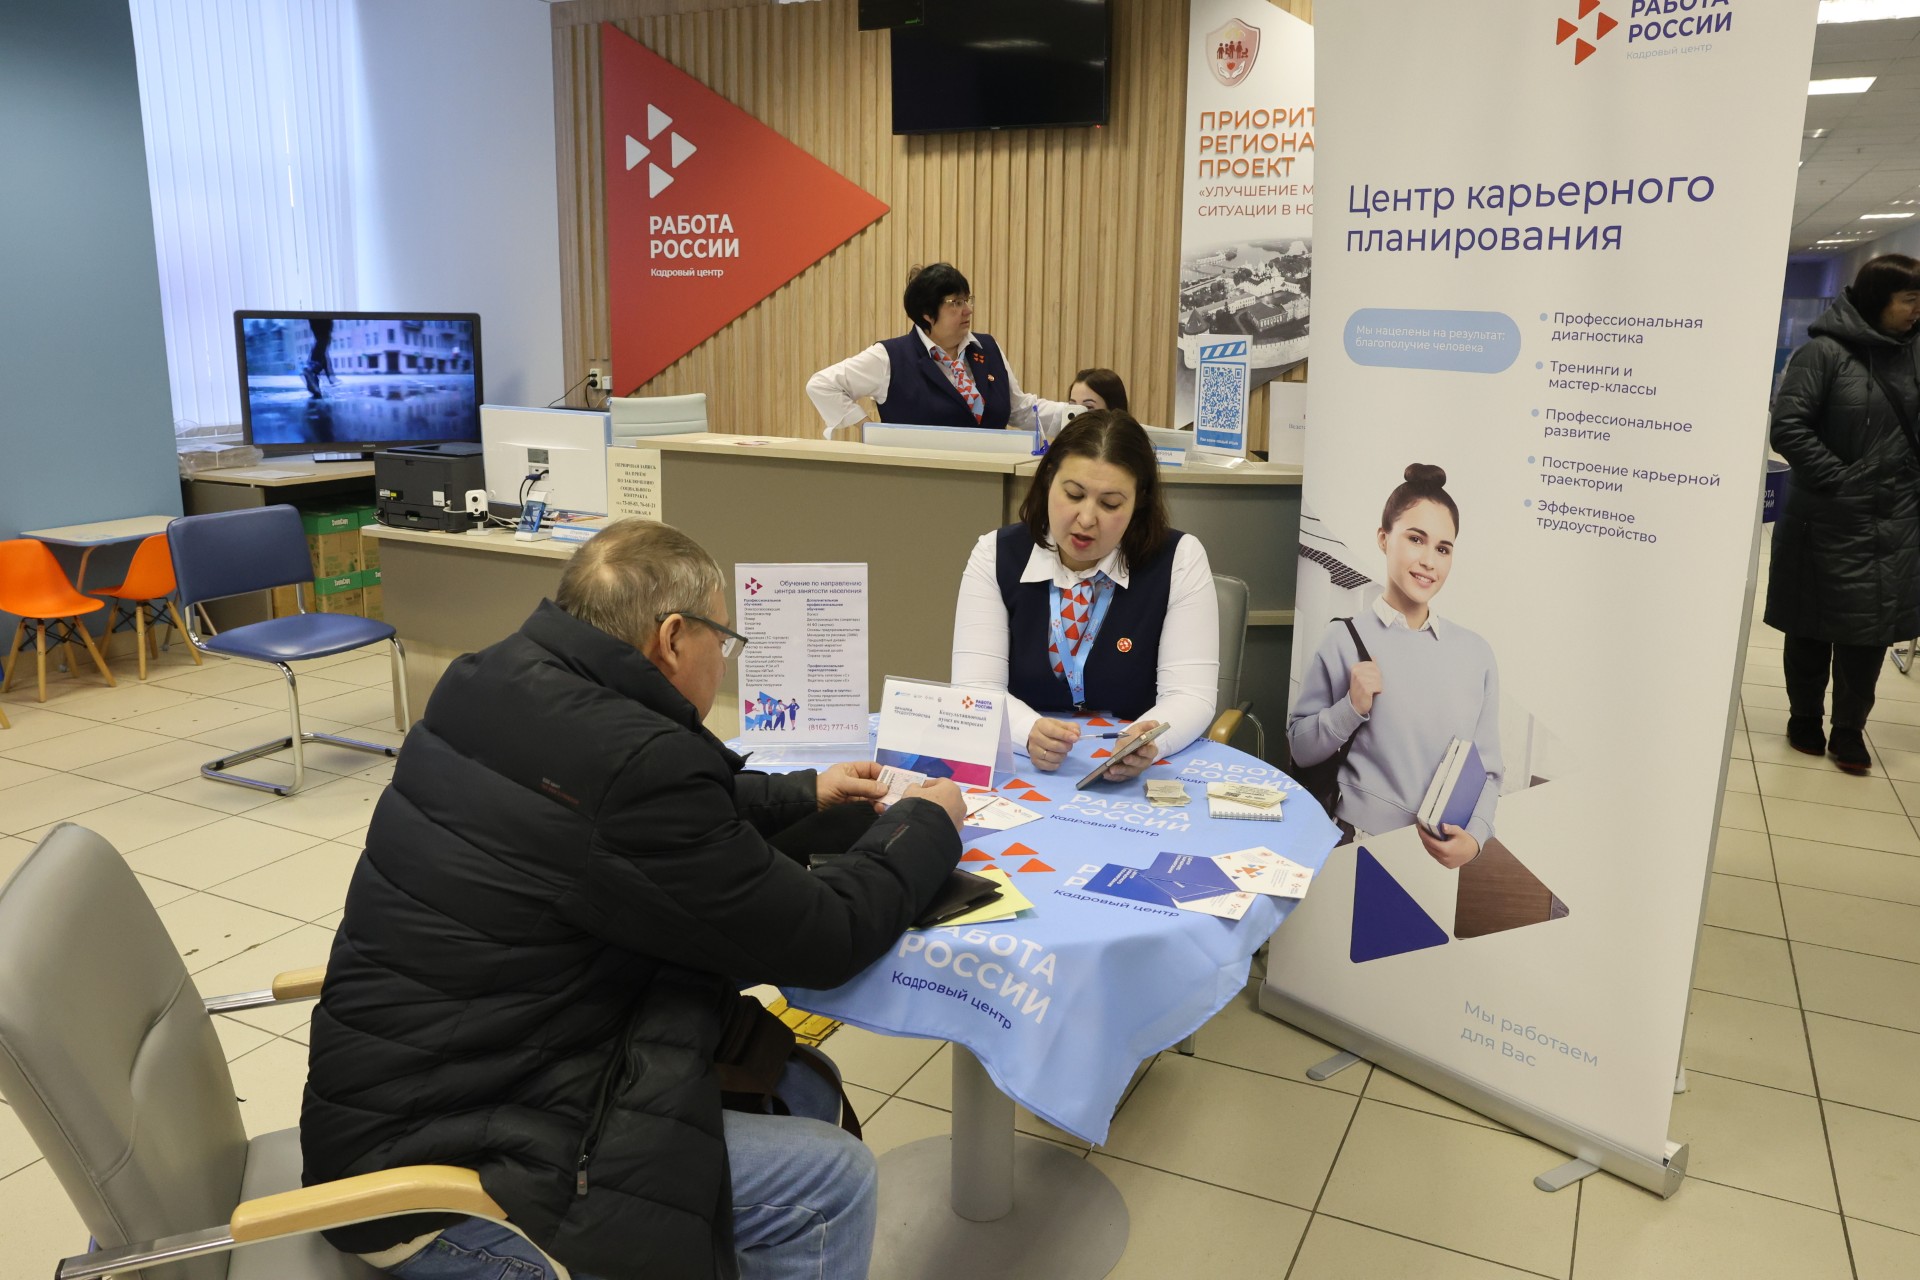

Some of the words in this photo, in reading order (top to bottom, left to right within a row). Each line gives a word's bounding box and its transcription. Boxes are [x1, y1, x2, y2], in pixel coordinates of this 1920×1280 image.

[1628, 12, 1732, 43] РОССИИ
[1626, 47, 1678, 60] Кадровый
[1681, 42, 1713, 54] центр
[1200, 107, 1316, 130] ПРИОРИТ
[1200, 131, 1315, 154] РЕГИОНА
[1199, 157, 1295, 177] ПРОЕКТ
[1199, 185, 1298, 198] «УЛУЧШЕНИЕ
[1302, 185, 1314, 196] М
[1348, 184, 1455, 218] Центр
[1467, 175, 1715, 216] карьерного
[1198, 205, 1277, 217] СИТУАЦИИ
[1282, 204, 1291, 215] В
[649, 214, 734, 235] РАБОТА
[650, 238, 739, 258] РОССИИ
[1346, 224, 1623, 259] планирования
[650, 267, 695, 278] Кадровый
[697, 268, 724, 278] центр
[1553, 312, 1704, 329] Профессиональная
[1356, 325, 1373, 335] Мы
[1375, 326, 1430, 338] нацелены
[1433, 328, 1446, 337] на
[1449, 330, 1505, 341] результат:
[1551, 329, 1644, 344] диагностика
[1355, 337, 1430, 352] благополучие
[1433, 341, 1484, 353] человека
[1550, 360, 1620, 377] Тренинги
[1623, 366, 1633, 377] и
[1548, 378, 1657, 396] мастер-классы
[1546, 408, 1693, 433] Профессиональное
[1544, 424, 1611, 441] развитие
[1540, 472, 1623, 492] траектории
[1542, 456, 1629, 477] Построение
[1632, 468, 1721, 487] карьерной
[1537, 499, 1636, 524] Эффективное
[1536, 515, 1657, 544] трудоустройство
[1175, 776, 1208, 785] Кадр
[1188, 759, 1291, 779] РАБОТ
[1058, 804, 1192, 832] РОССИИ
[1070, 794, 1190, 821] РАБОТА
[1050, 814, 1117, 829] Кадровый
[1119, 826, 1160, 837] центр
[1053, 889, 1130, 909] Кадровый
[1133, 905, 1180, 917] центр
[934, 926, 1057, 986] АБОТА
[897, 933, 1052, 1025] РОССИИ
[891, 970, 969, 1001] Кадровый
[970, 997, 1012, 1030] центр
[1464, 1000, 1495, 1025] Мы
[1500, 1017, 1599, 1068] работаем
[1460, 1027, 1495, 1051] для
[1501, 1042, 1537, 1068] Вас
